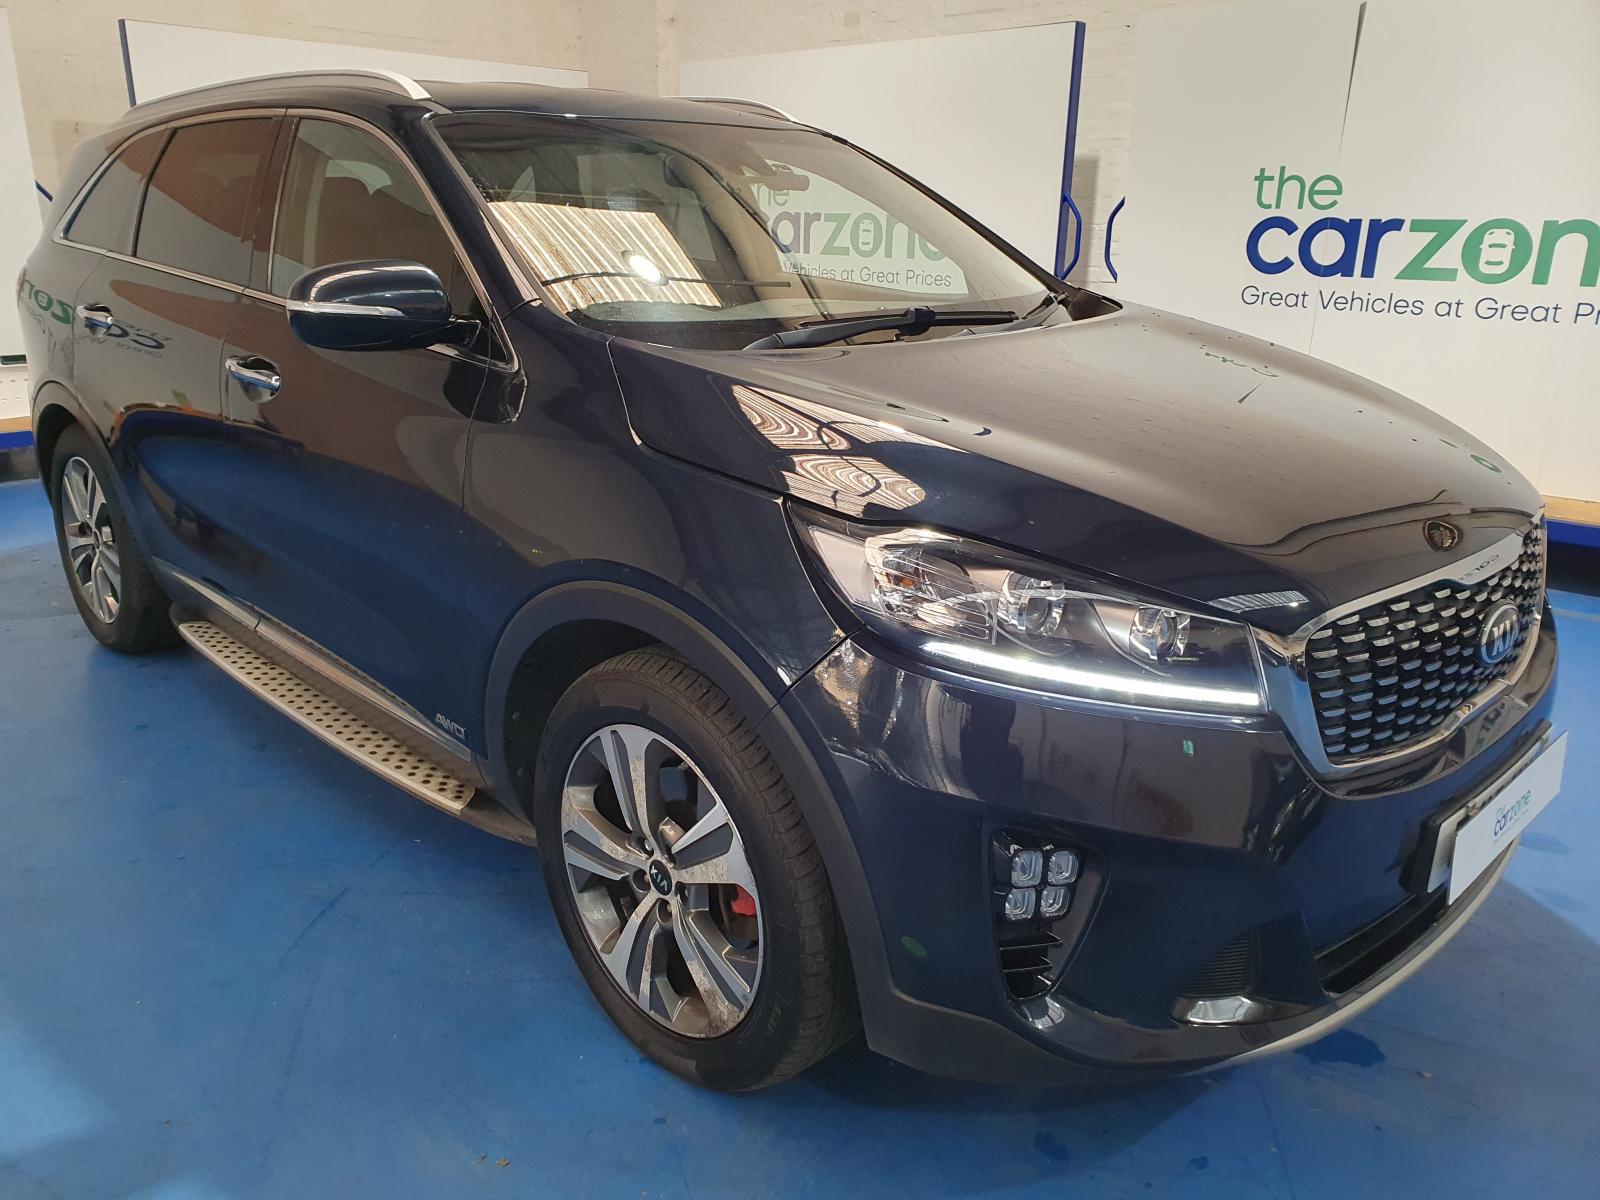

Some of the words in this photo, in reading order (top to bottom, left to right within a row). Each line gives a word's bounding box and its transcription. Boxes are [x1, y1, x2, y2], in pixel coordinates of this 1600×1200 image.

[1254, 165, 1344, 211] the
[840, 268, 855, 281] at
[859, 266, 901, 285] Great
[905, 269, 952, 288] Prices
[1241, 284, 1309, 310] Great
[1318, 289, 1424, 316] Vehicles
[1434, 298, 1464, 319] at
[1474, 296, 1563, 324] Great
[1491, 613, 1520, 657] KIA
[1494, 789, 1531, 837] carzone
[650, 864, 668, 892] KIA
